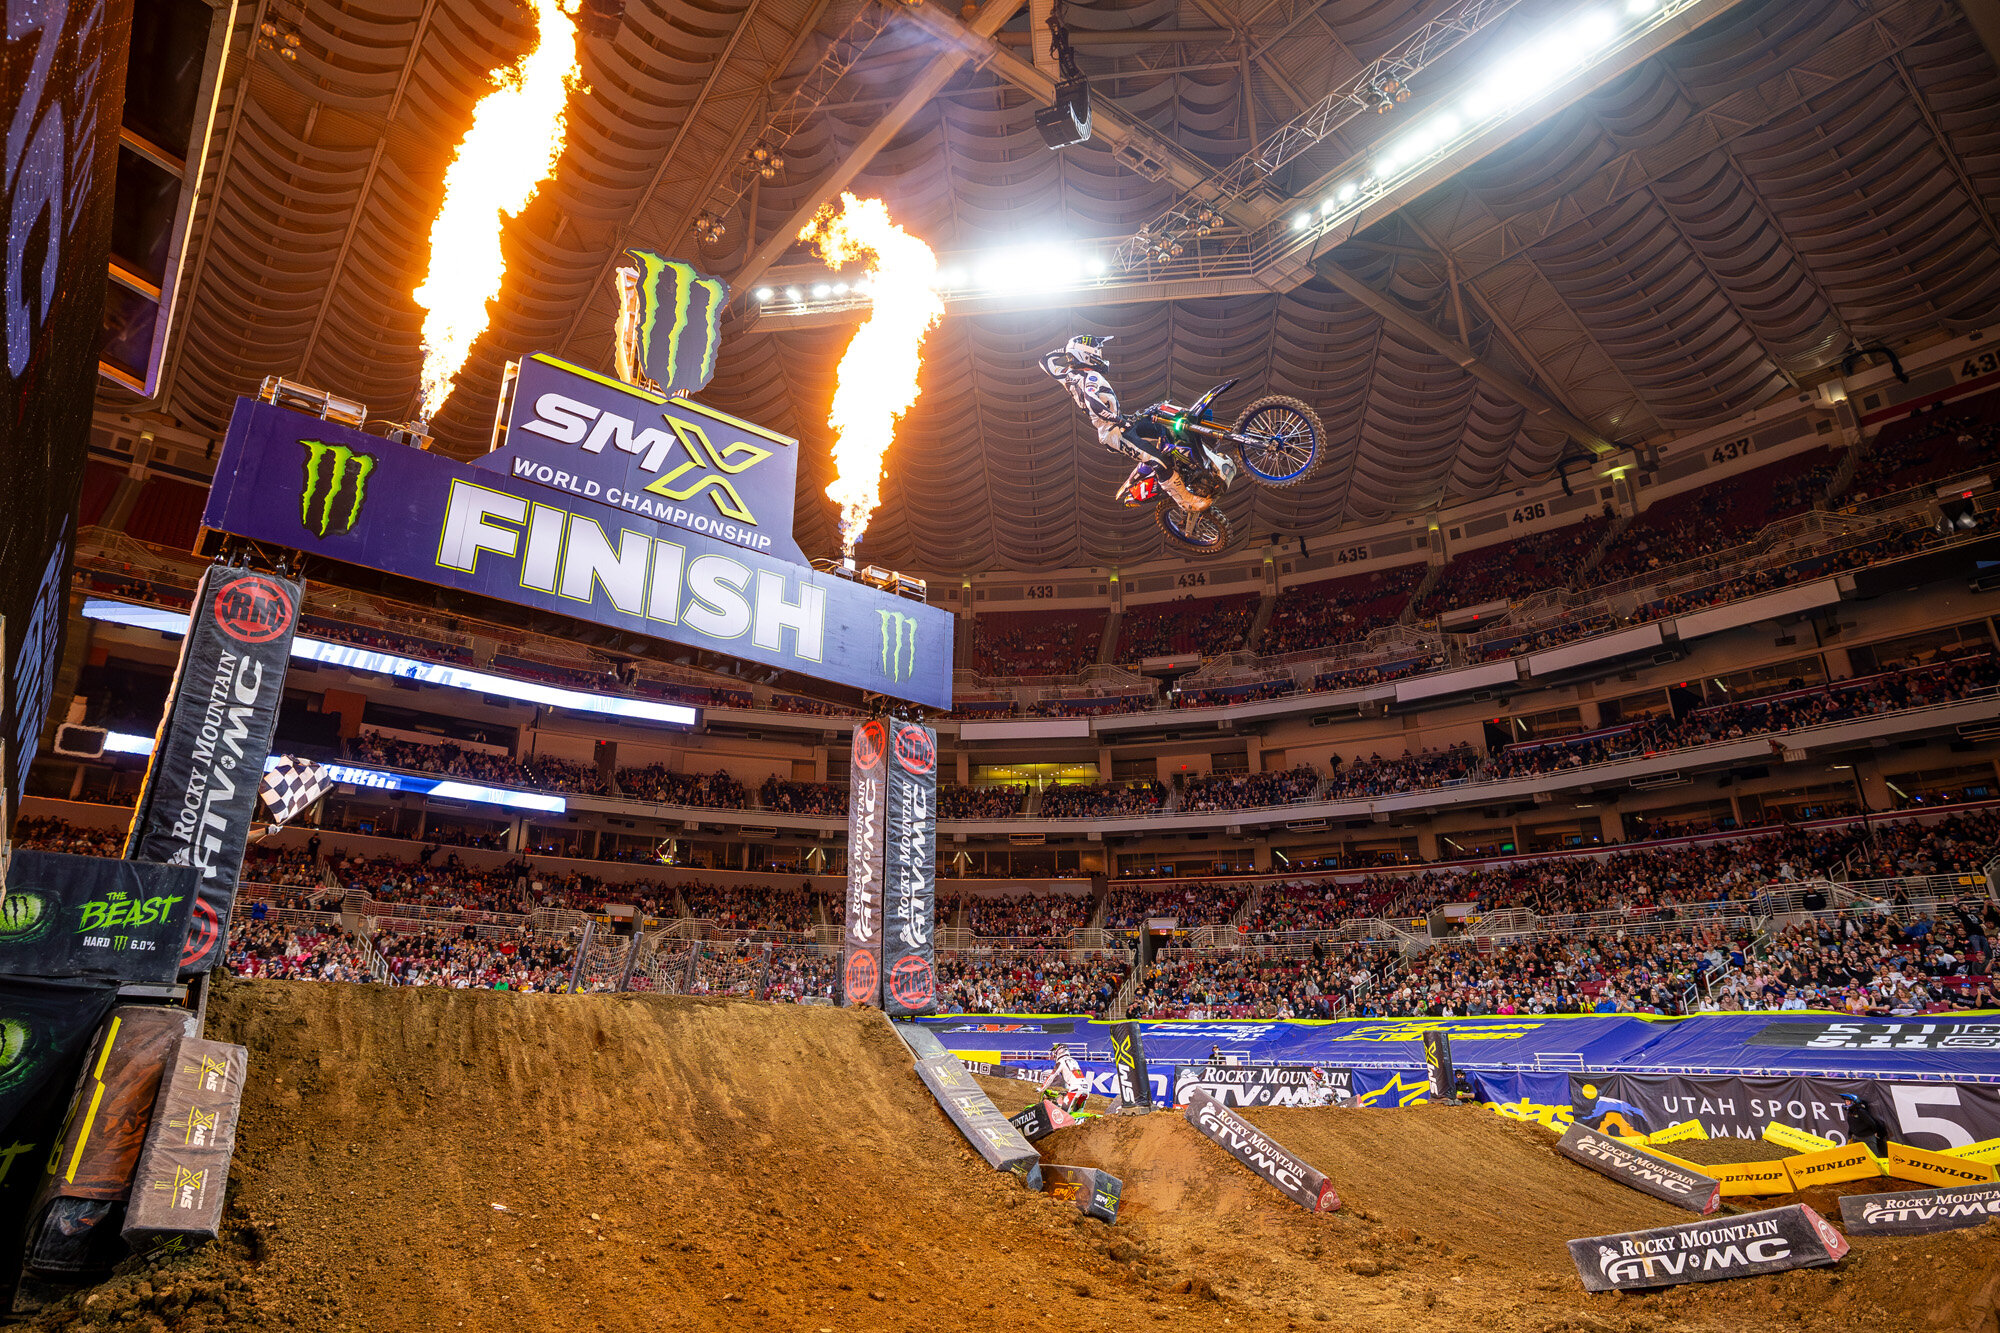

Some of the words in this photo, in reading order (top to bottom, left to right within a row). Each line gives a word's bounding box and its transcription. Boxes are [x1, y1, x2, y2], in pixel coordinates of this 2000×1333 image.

[520, 393, 774, 525] SMX
[1711, 438, 1749, 464] 437
[514, 457, 601, 497] WORLD
[606, 488, 772, 550] CHAMPIONSHIP
[1512, 503, 1546, 524] 436
[435, 478, 827, 664] FINISH
[1337, 549, 1368, 563] 435
[1027, 585, 1053, 599] 433
[1178, 572, 1206, 587] 434
[171, 766, 208, 842] ROCKY
[191, 649, 237, 767] MOUNTAIN
[854, 780, 866, 861] MOUNTAIN
[900, 781, 912, 867] MOUNTAIN
[106, 891, 129, 901] THE
[852, 864, 863, 914] ROCKY
[898, 867, 911, 920] ROCKY
[73, 894, 184, 934] BEAST
[83, 936, 111, 948] HARD
[130, 939, 156, 951] 6.0%
[1202, 1067, 1257, 1084] ROCKY
[1260, 1067, 1351, 1087] MOUNAIN
[1662, 1096, 1736, 1116] UTAH
[1216, 1109, 1250, 1138] ROCKY
[1248, 1133, 1306, 1178] MOUNTAIN
[1598, 1140, 1635, 1161] ROCKY
[1632, 1155, 1697, 1185] MOUNTAIN
[1725, 1172, 1784, 1183] DUNLOP
[1806, 1156, 1867, 1175] DUNLOP
[1907, 1159, 1988, 1182] DUNLOP
[180, 1168, 203, 1210] SMX
[1885, 1197, 1932, 1209] ROCKY
[1620, 1237, 1676, 1257] ROCKY
[1678, 1219, 1779, 1250] MOUNTAIN
